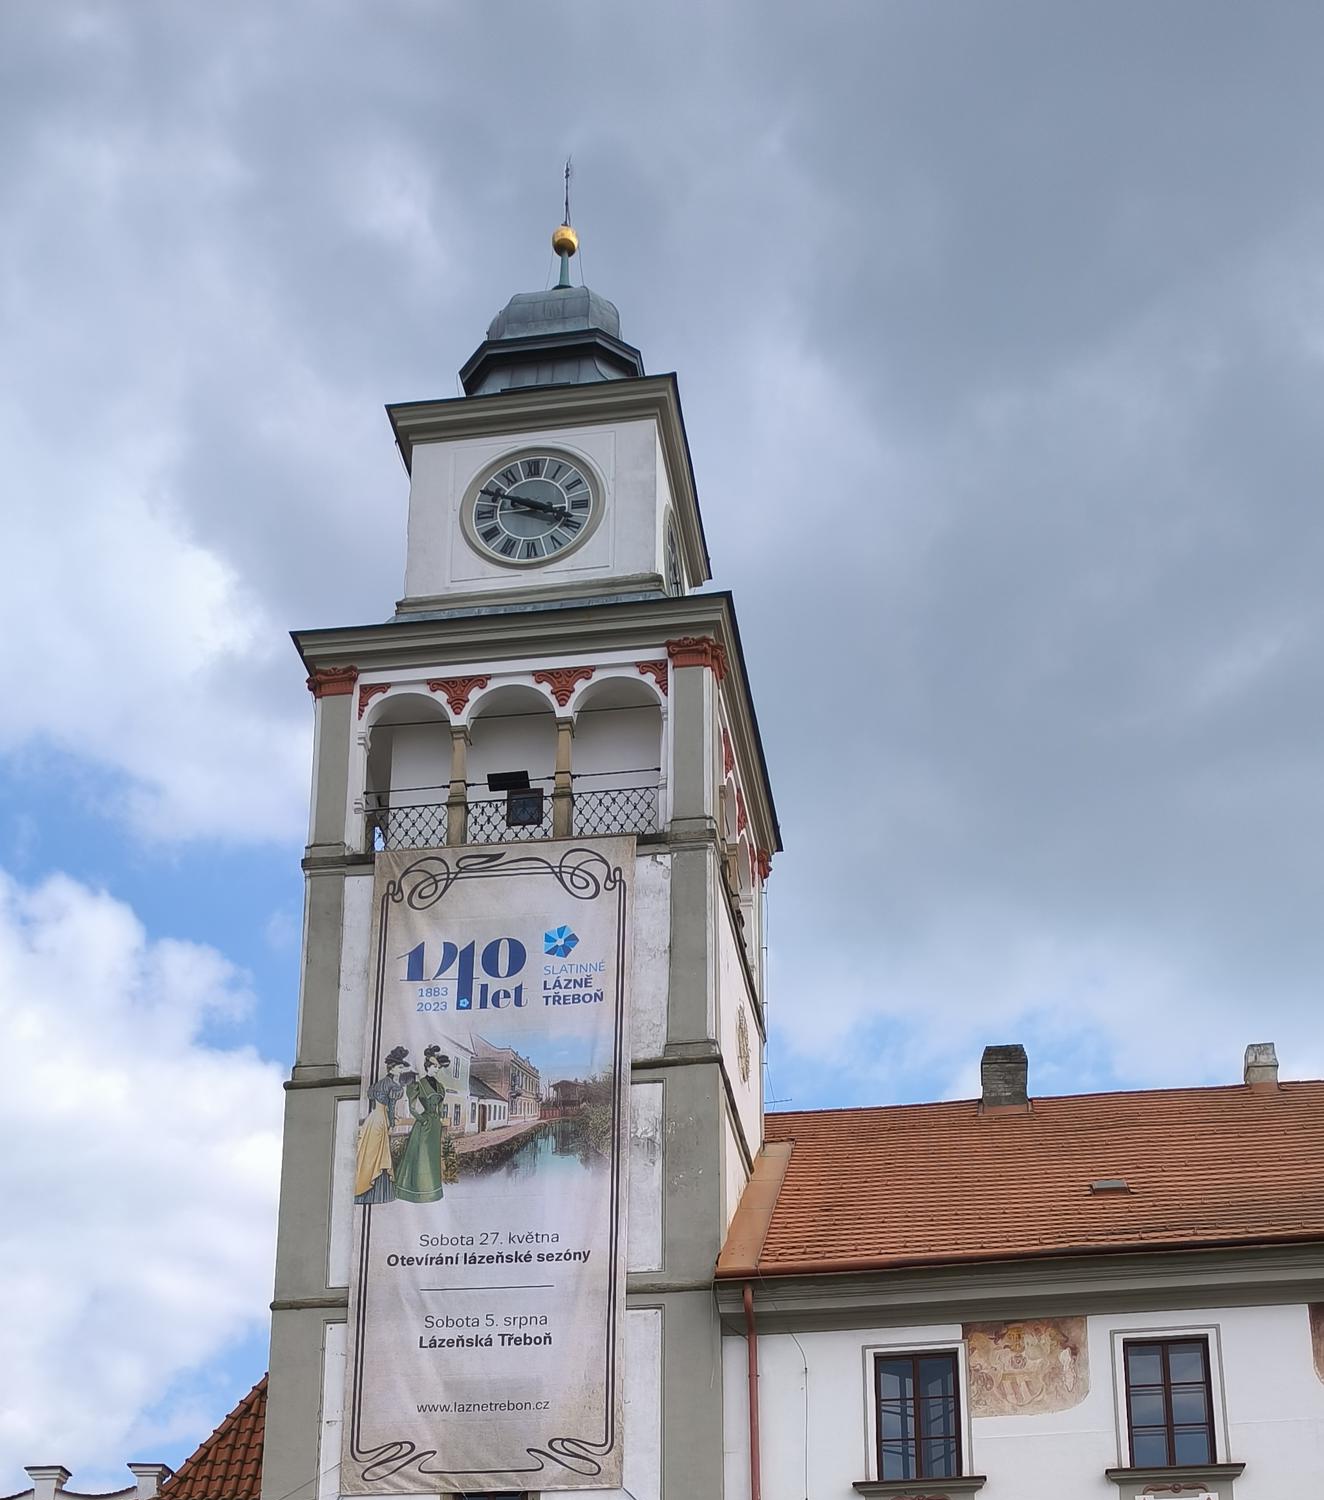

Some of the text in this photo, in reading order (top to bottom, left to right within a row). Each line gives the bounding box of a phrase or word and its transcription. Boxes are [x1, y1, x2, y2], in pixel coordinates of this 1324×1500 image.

[396, 937, 527, 1011] 140
[543, 961, 605, 975] SLATINNÉ
[543, 974, 593, 991] LÁZNĚ
[417, 986, 448, 998] 1883
[474, 982, 528, 1010] let
[543, 988, 604, 1006] TŘEBOŇ
[416, 1000, 448, 1012] 2023
[419, 1231, 560, 1248] Sobota 27. května
[386, 1249, 591, 1267] Otevírání lázeňské sezóny
[424, 1314, 548, 1329] Sobota 5. srpna
[418, 1332, 553, 1349] Lázeňská Třeboň
[416, 1400, 550, 1414] www.laznetrebon.cz
